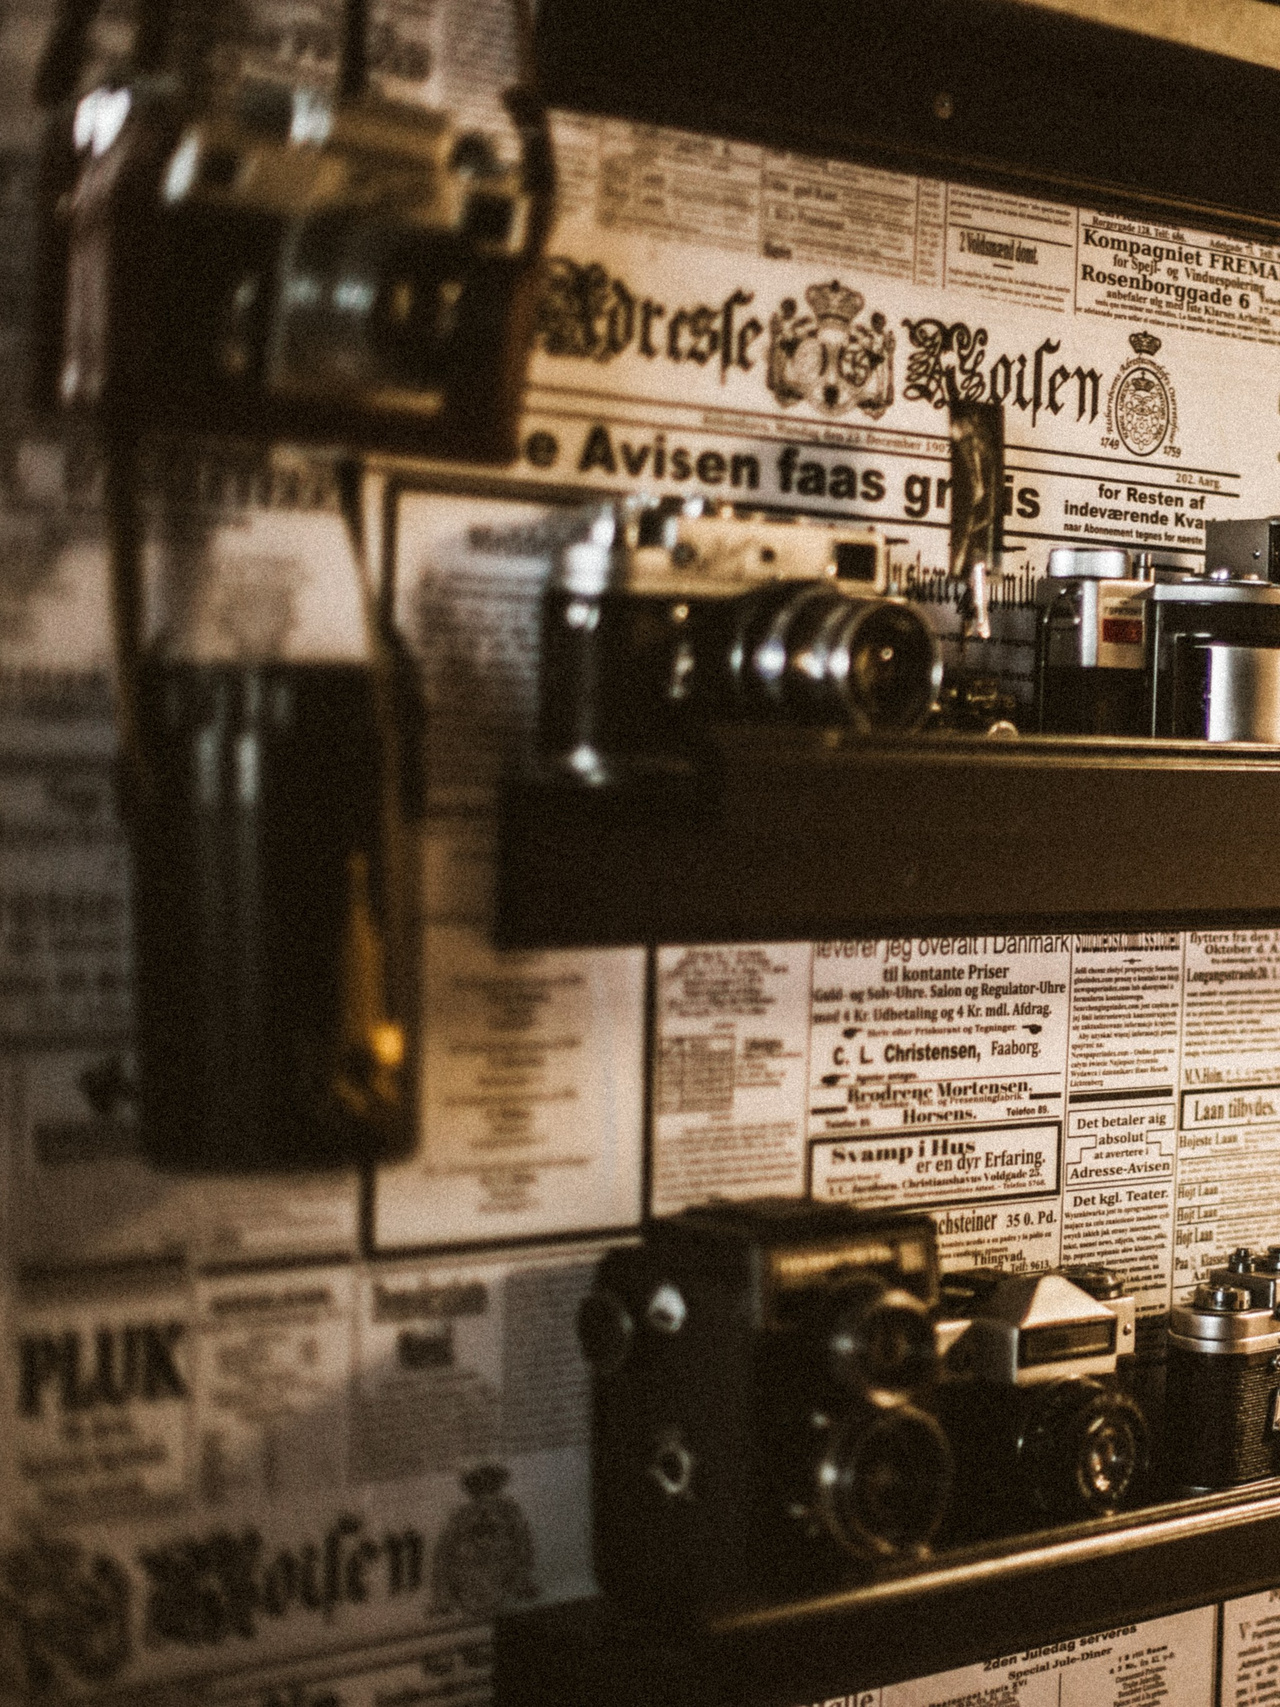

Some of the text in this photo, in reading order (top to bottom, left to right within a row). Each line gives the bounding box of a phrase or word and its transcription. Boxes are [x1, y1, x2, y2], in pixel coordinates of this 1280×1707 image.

[1083, 228, 1203, 266] Kompagniet
[1113, 253, 1129, 268] for
[1166, 267, 1179, 281] og
[1080, 263, 1233, 307] Rosenborggade
[1239, 293, 1250, 310] 6
[577, 422, 761, 491] Avisen
[777, 446, 887, 502] faas
[903, 473, 1042, 519] gris
[1097, 483, 1207, 511] for Resten af
[1063, 500, 1169, 526] indeværende
[1083, 522, 1134, 538] Abonnement
[882, 963, 1010, 982] til kontante Priser
[930, 982, 962, 998] Salon
[964, 985, 979, 1000] og
[980, 981, 1067, 1000] Regulator-Uhre
[940, 1007, 955, 1023] og
[957, 1005, 964, 1018] 4
[967, 1003, 983, 1018] Kr.
[985, 1002, 1010, 1017] mdl.
[1012, 1001, 1053, 1018] Afdrag.
[884, 1042, 982, 1064] Christensen,
[990, 1038, 1042, 1058] Faaborg.
[937, 1079, 1033, 1096] Mortensen.
[902, 1107, 977, 1125] Horsens.
[1076, 1118, 1099, 1130] Det
[1101, 1114, 1145, 1127] betaler
[918, 1139, 926, 1157] i
[931, 1136, 977, 1157] Hus
[1098, 1131, 1145, 1146] absolut
[916, 1148, 1046, 1174] er en dyr Erfaring.
[1094, 1151, 1103, 1160] at
[1105, 1148, 1144, 1158] avertere
[1069, 1161, 1171, 1180] Adresse-Avisen
[1073, 1189, 1169, 1208] Det kgl. Teater.
[937, 1209, 998, 1236] chsteiner
[1038, 1209, 1057, 1224] Pd.
[1021, 1638, 1077, 1663] Juledag
[1079, 1624, 1137, 1647] serveres
[1007, 1647, 1113, 1682] Special Jule-Diner
